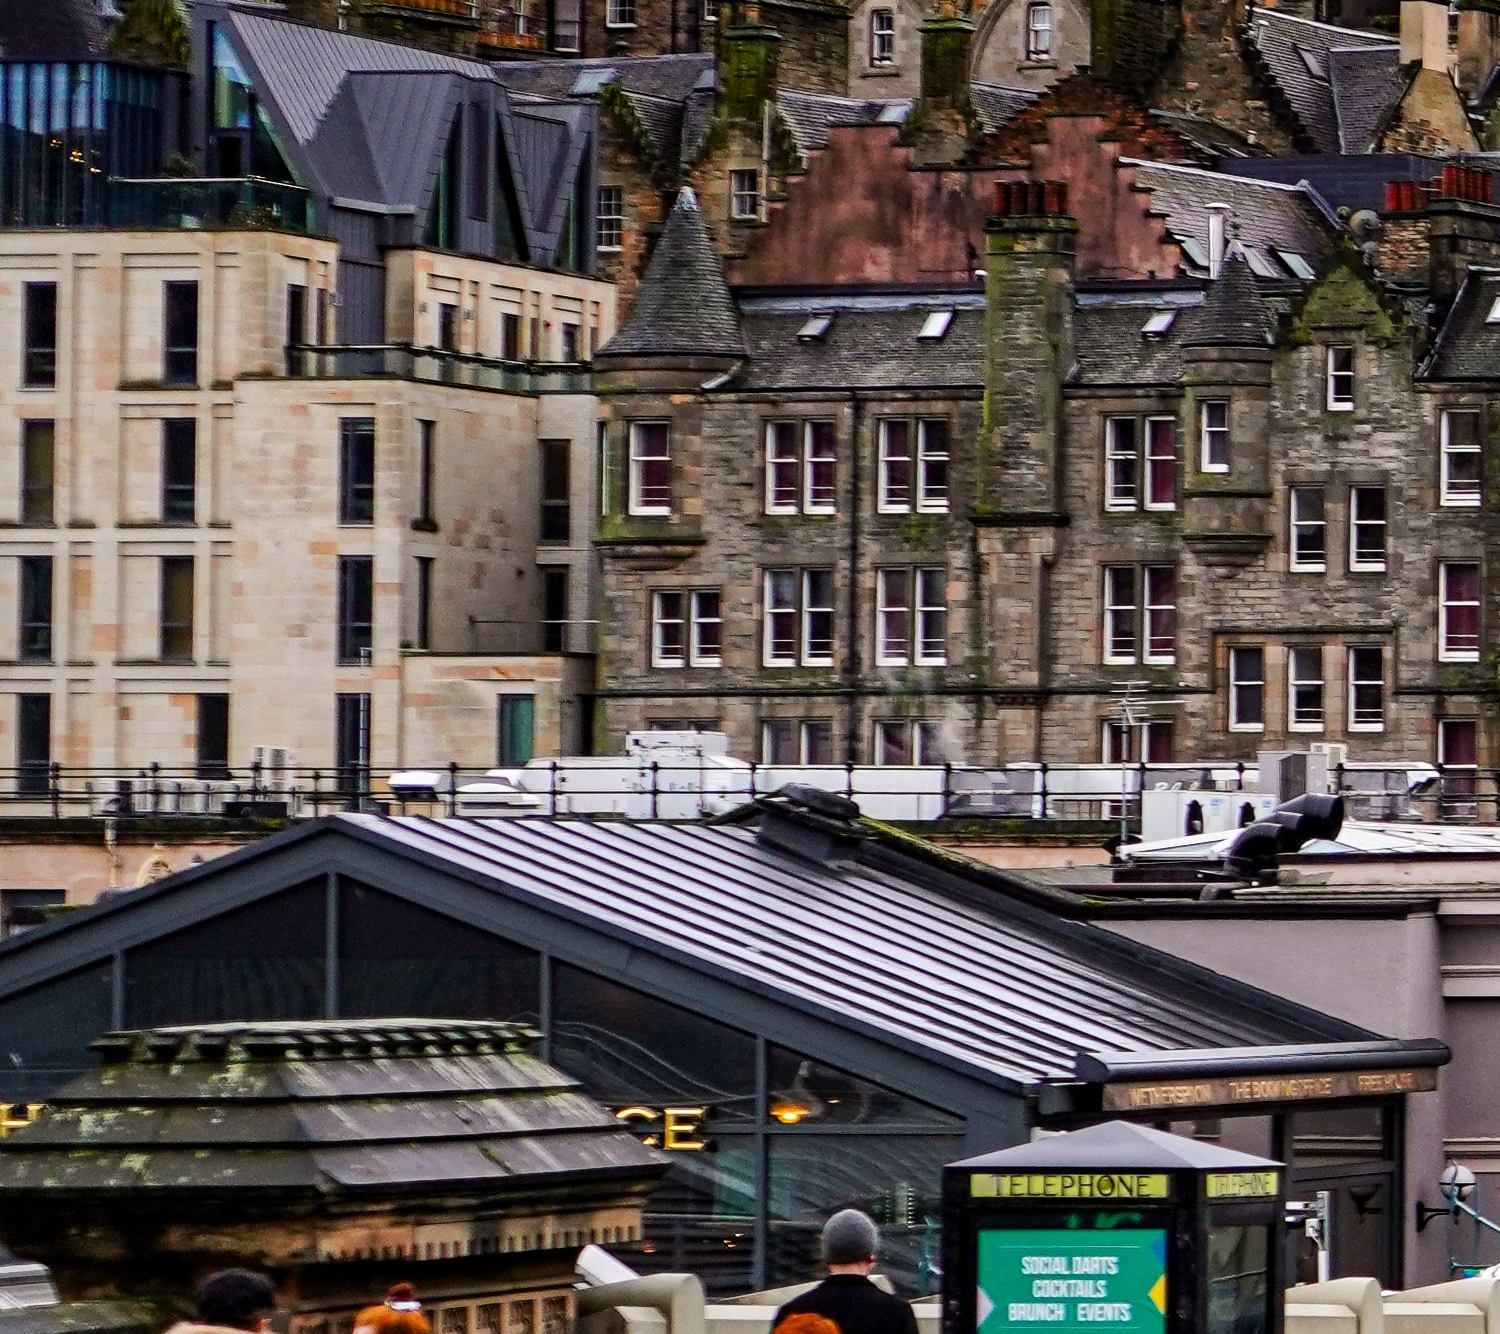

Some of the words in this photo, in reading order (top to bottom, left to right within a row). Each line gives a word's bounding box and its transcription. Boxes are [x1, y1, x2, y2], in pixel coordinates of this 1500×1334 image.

[991, 1175, 1152, 1197] TELEPHONE
[1021, 1256, 1070, 1275] SOCIAL
[1071, 1256, 1118, 1275] DARTS
[1032, 1280, 1107, 1298] COCKTAILS
[1008, 1303, 1065, 1322] BRUNCH
[1077, 1303, 1132, 1322] EVENTS
